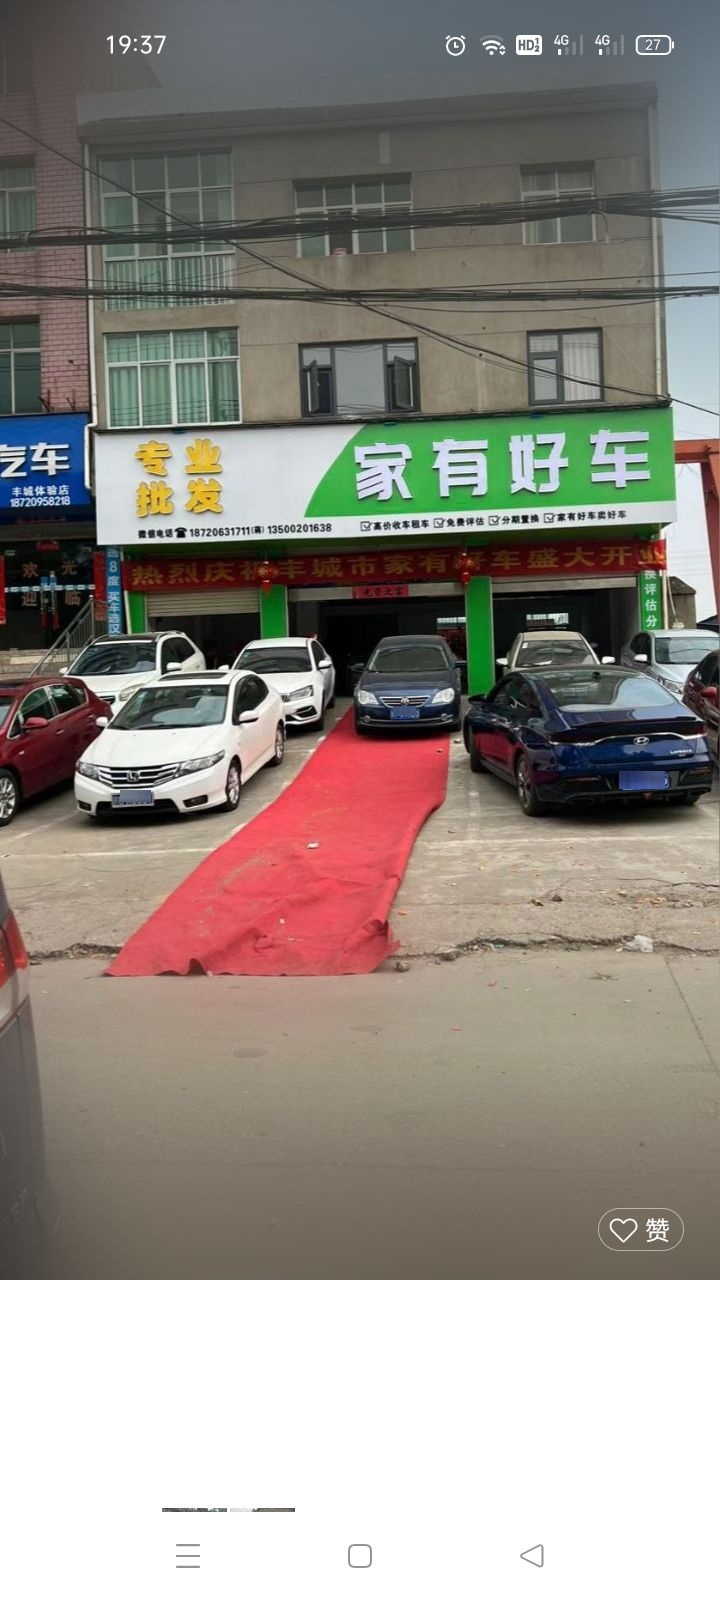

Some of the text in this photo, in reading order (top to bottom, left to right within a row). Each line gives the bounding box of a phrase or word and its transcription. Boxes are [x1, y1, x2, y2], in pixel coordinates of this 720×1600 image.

[134, 438, 224, 477] 专业
[354, 429, 650, 500] 家有好车
[12, 484, 69, 497] 丰城体验店
[135, 477, 224, 518] 批发
[10, 496, 71, 508] 18720958218
[138, 528, 173, 539] 微信电话
[267, 523, 332, 535] 13500201638
[373, 518, 430, 531] 高价收车租车
[446, 517, 485, 528] 免费评估
[502, 513, 539, 525] 分期置换
